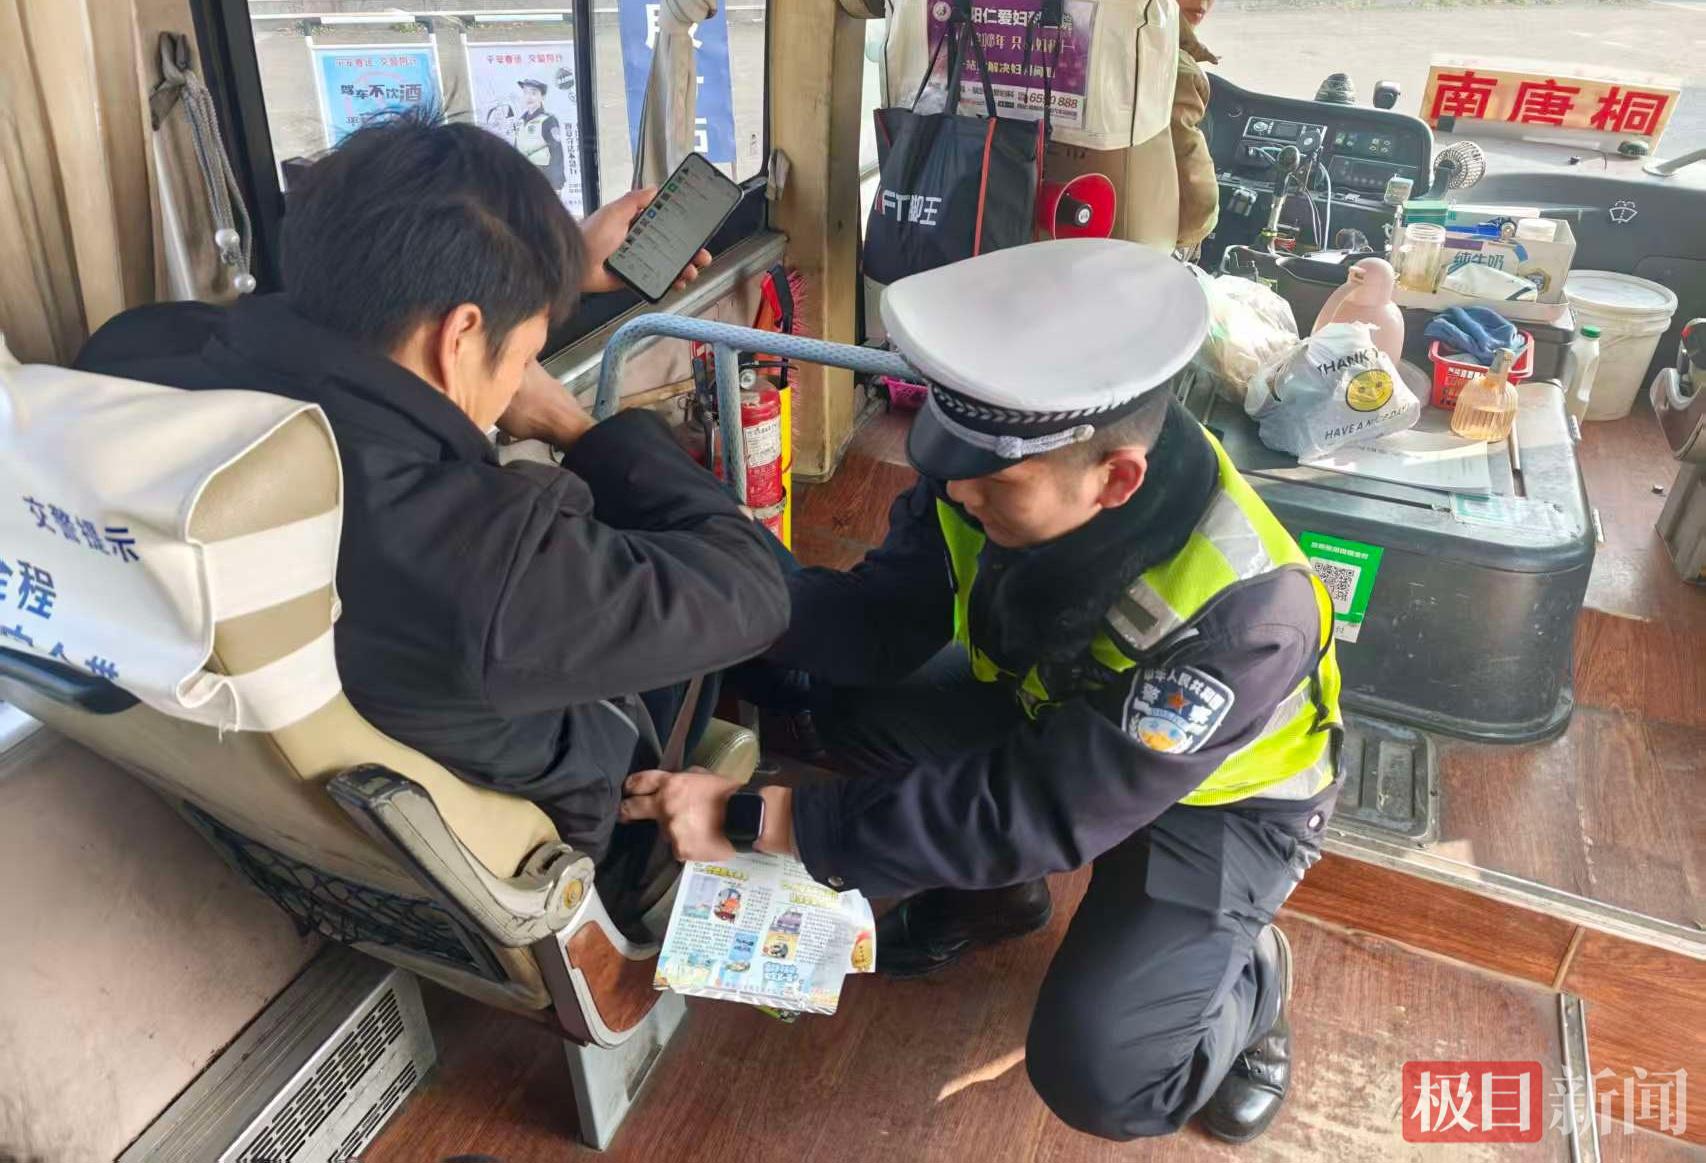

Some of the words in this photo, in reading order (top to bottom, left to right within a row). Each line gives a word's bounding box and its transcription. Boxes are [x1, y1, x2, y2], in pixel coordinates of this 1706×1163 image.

[340, 83, 423, 103] 驾车不饮酒
[1029, 92, 1057, 107] 650
[1431, 71, 1669, 137] 南唐桐
[1454, 251, 1505, 271] 纯牛奶
[1316, 349, 1370, 375] THANK
[1324, 423, 1354, 440] HAVE
[22, 495, 141, 563] 交警提示
